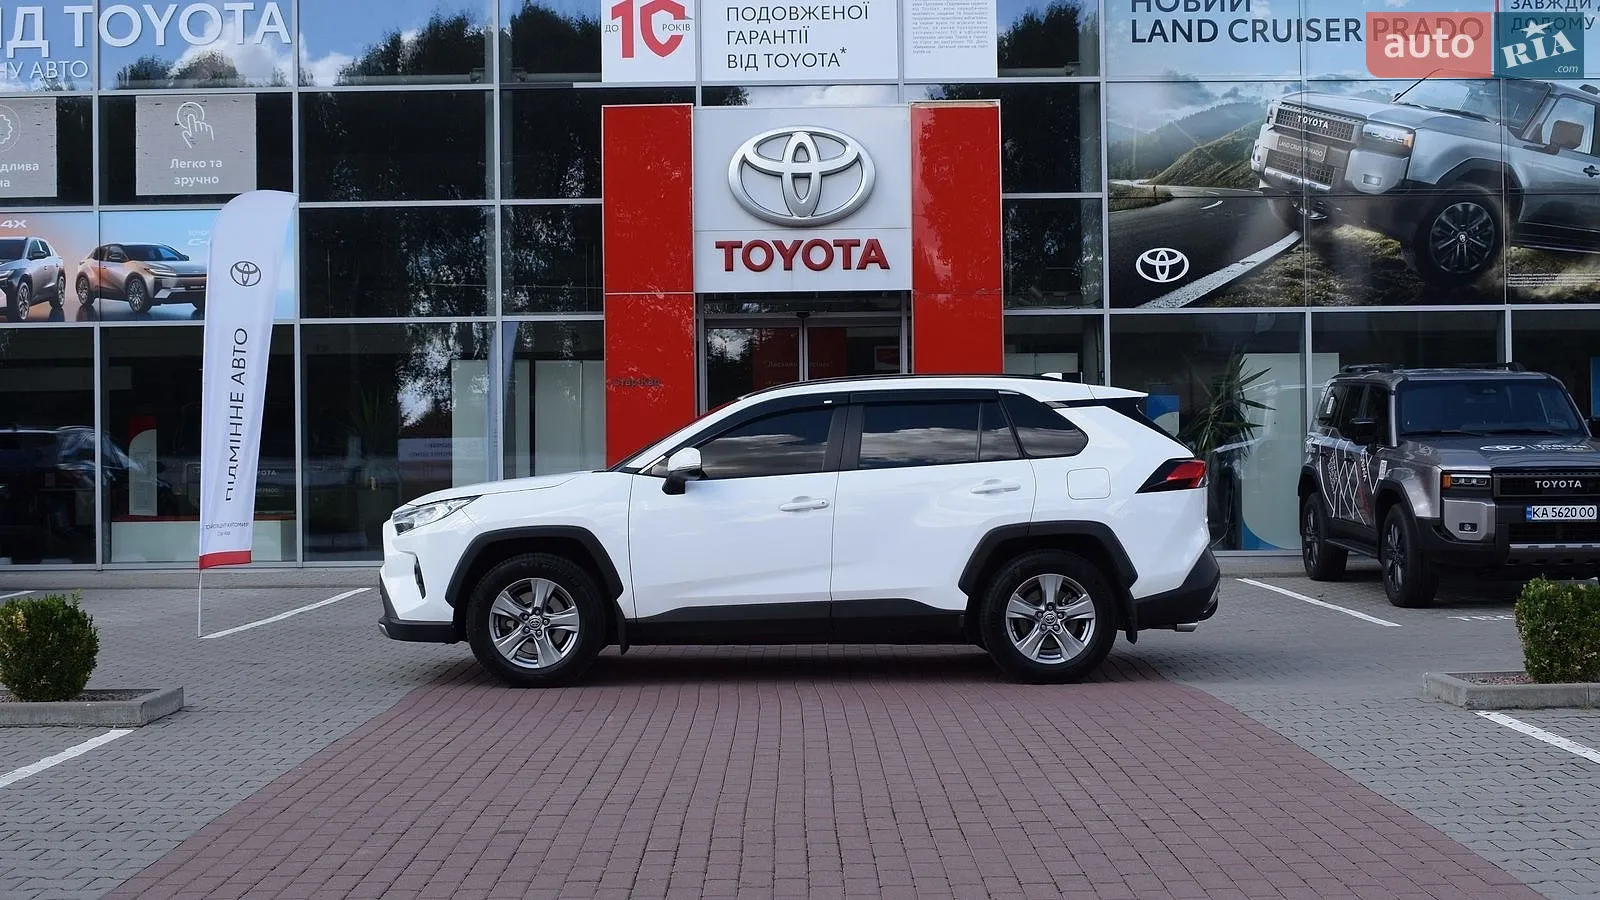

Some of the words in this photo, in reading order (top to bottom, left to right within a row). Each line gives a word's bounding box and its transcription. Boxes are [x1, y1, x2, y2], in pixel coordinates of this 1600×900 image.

[727, 1, 870, 24] ПОДОВЖЕНОЇ
[1511, 0, 1591, 12] ЗАВЖДИ
[64, 2, 292, 48] TOYOTA
[605, 24, 619, 33] ДО
[662, 23, 691, 32] РОКІВ
[1131, 19, 1219, 43] LAND
[1228, 18, 1363, 43] CRUISER
[1372, 17, 1484, 42] PRADO
[727, 26, 810, 45] ГАРАНТІЇ
[30, 60, 89, 79] АВТО
[727, 53, 759, 71] ВІД
[1297, 115, 1329, 130] TOYOTA
[170, 158, 207, 169] Легко
[209, 160, 223, 168] та
[174, 176, 220, 188] зручно
[715, 238, 890, 272] TOYOTA
[231, 328, 248, 386] АВТО
[1534, 480, 1583, 489] TOYOTA
[1532, 506, 1549, 519] KA
[1551, 506, 1577, 519] 5620
